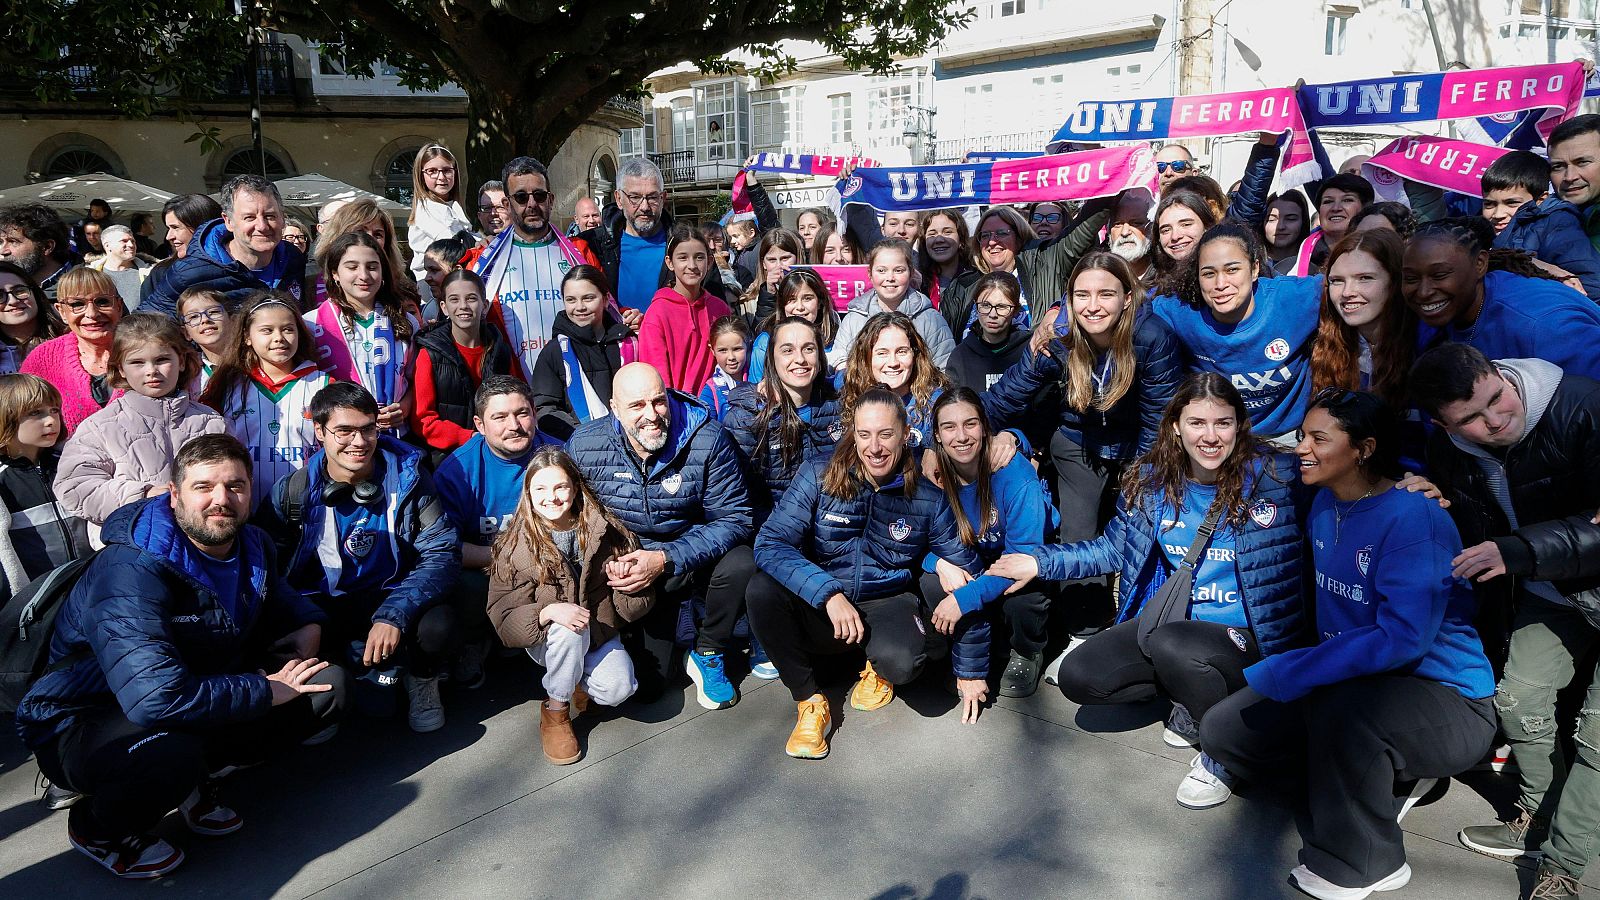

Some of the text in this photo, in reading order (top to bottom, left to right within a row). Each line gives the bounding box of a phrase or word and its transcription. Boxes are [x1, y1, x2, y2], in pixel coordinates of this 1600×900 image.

[1070, 97, 1290, 134] UNI FERROL
[1316, 81, 1423, 115] UNI
[776, 190, 811, 205] CASA
[888, 160, 1109, 201] UNI FERROL
